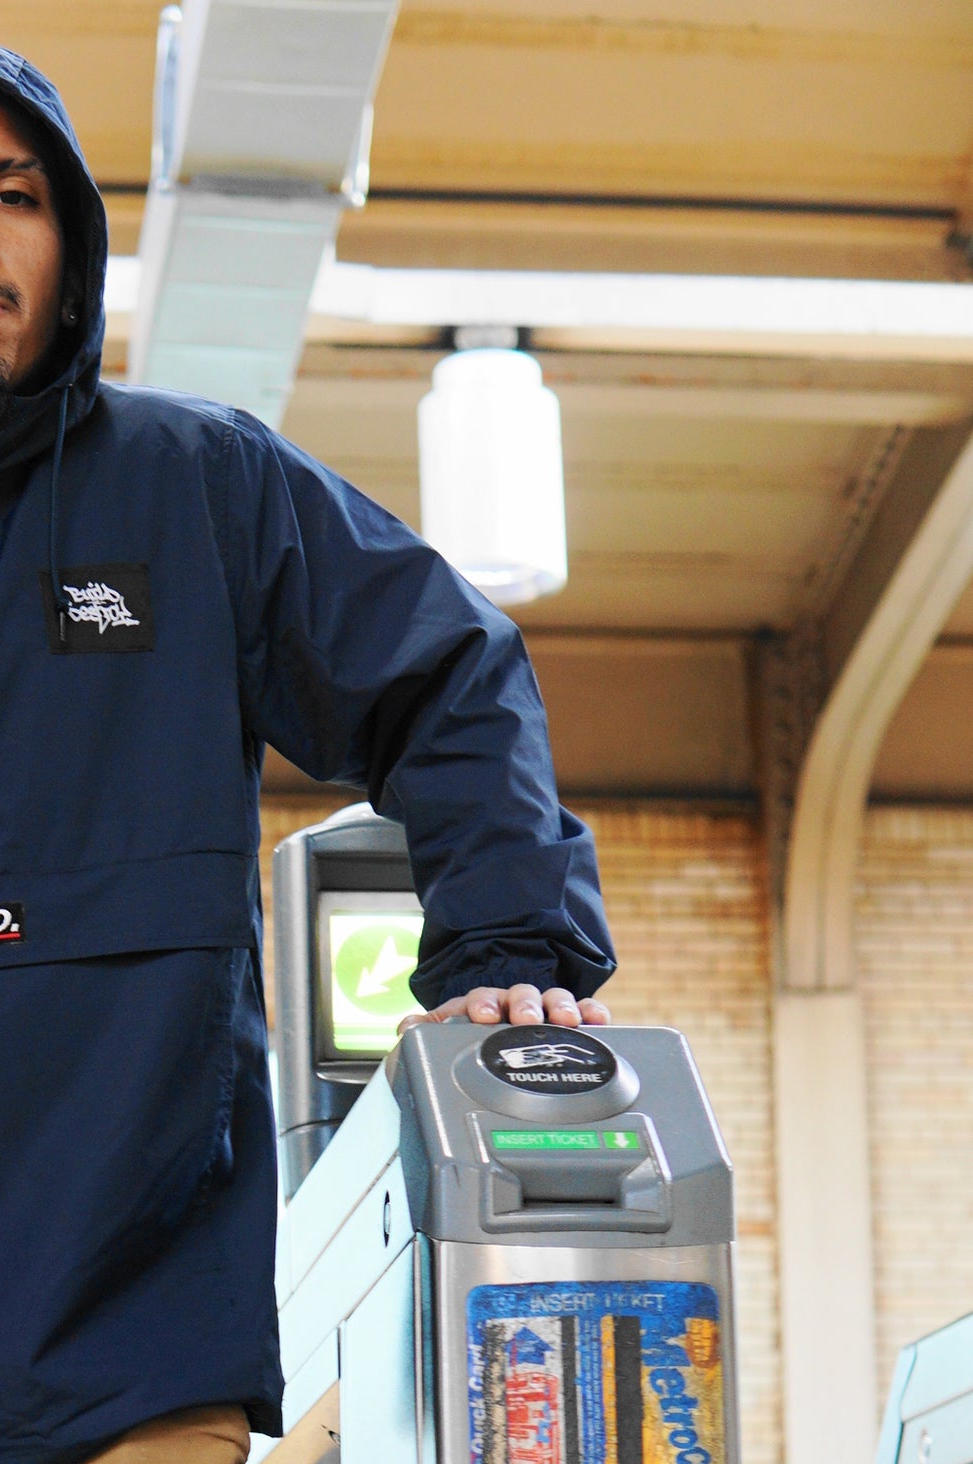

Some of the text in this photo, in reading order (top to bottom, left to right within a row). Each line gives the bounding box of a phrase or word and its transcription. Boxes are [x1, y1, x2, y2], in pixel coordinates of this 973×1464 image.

[506, 1072, 603, 1083] TOUCH HERE
[496, 1133, 596, 1145] INSERT TICKET
